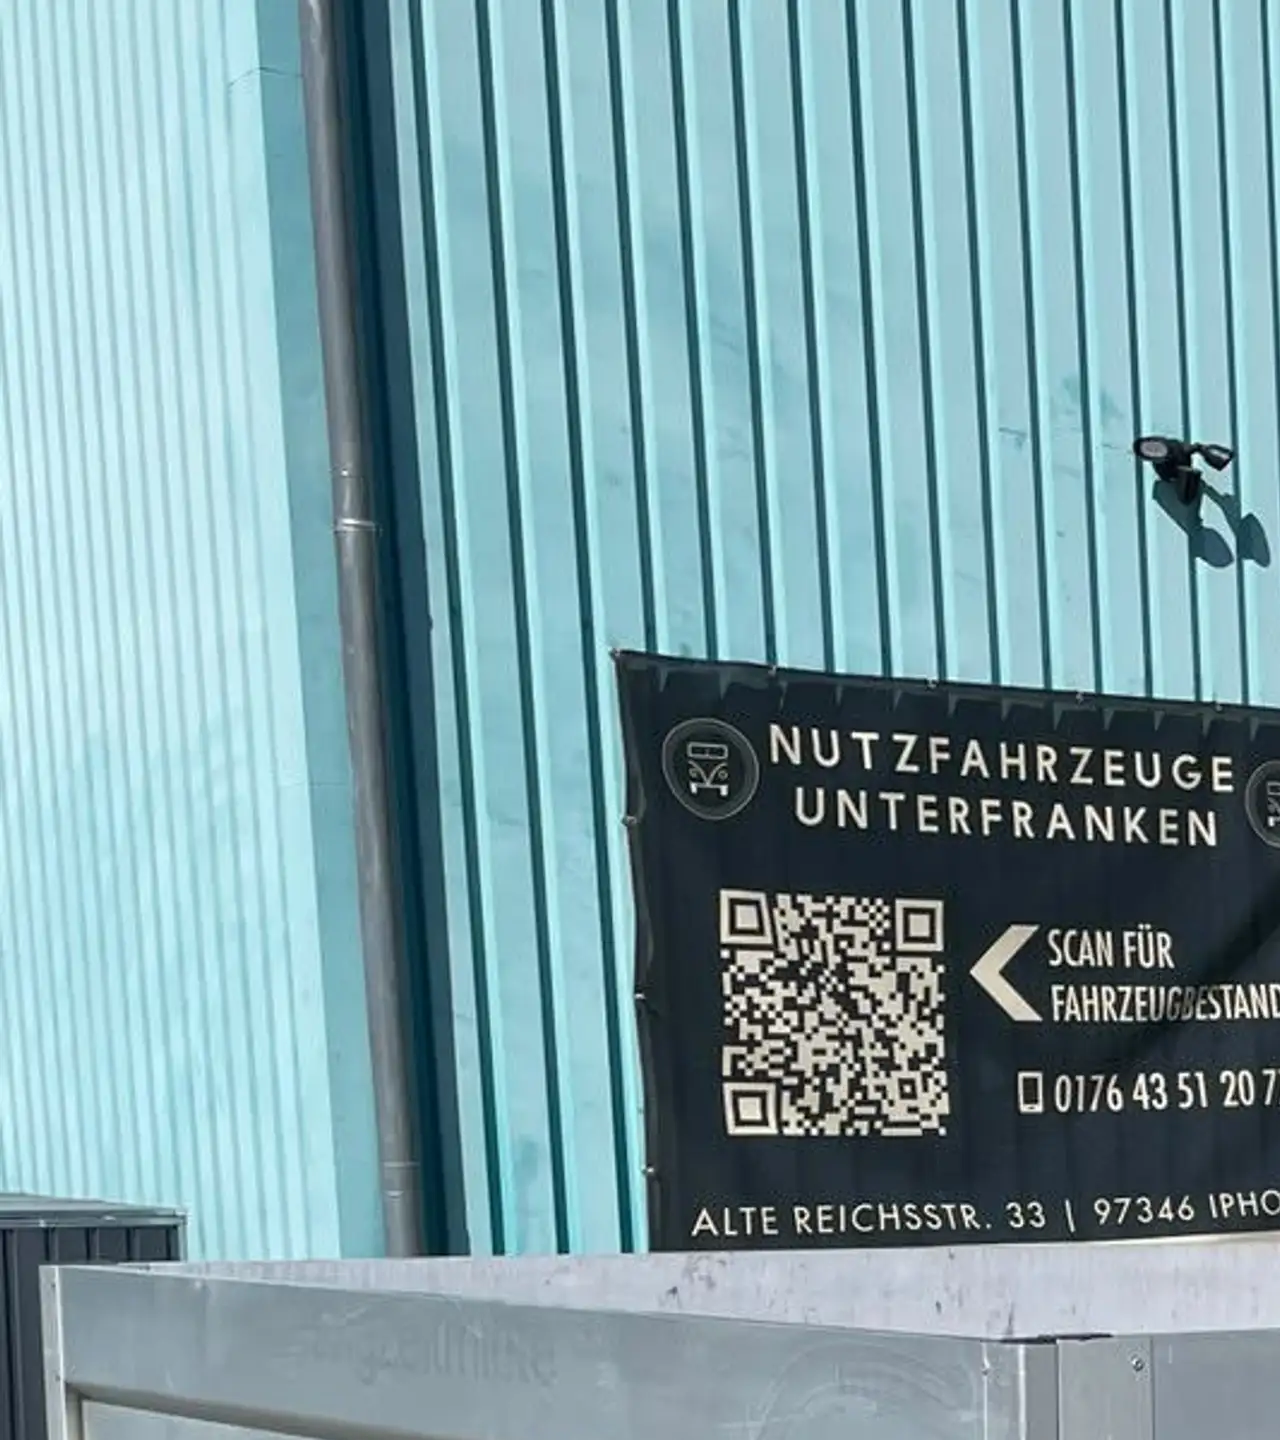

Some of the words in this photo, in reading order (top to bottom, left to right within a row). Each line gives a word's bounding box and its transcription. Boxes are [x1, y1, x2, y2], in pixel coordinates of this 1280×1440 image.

[769, 724, 1234, 792] NUTZFAHRZEUGE
[795, 786, 1217, 847] UNTERFRANKEN
[1047, 928, 1113, 968] SCAN
[1122, 923, 1175, 969] FÜR
[1054, 1073, 1125, 1113] 0176
[1132, 1071, 1168, 1110] 43
[1177, 1070, 1209, 1109] 51
[1219, 1068, 1257, 1108] 20
[691, 1206, 780, 1237] ALTE
[793, 1202, 993, 1235] REICHSSTR.
[1005, 1201, 1047, 1229] 33
[1093, 1195, 1196, 1225] 97346
